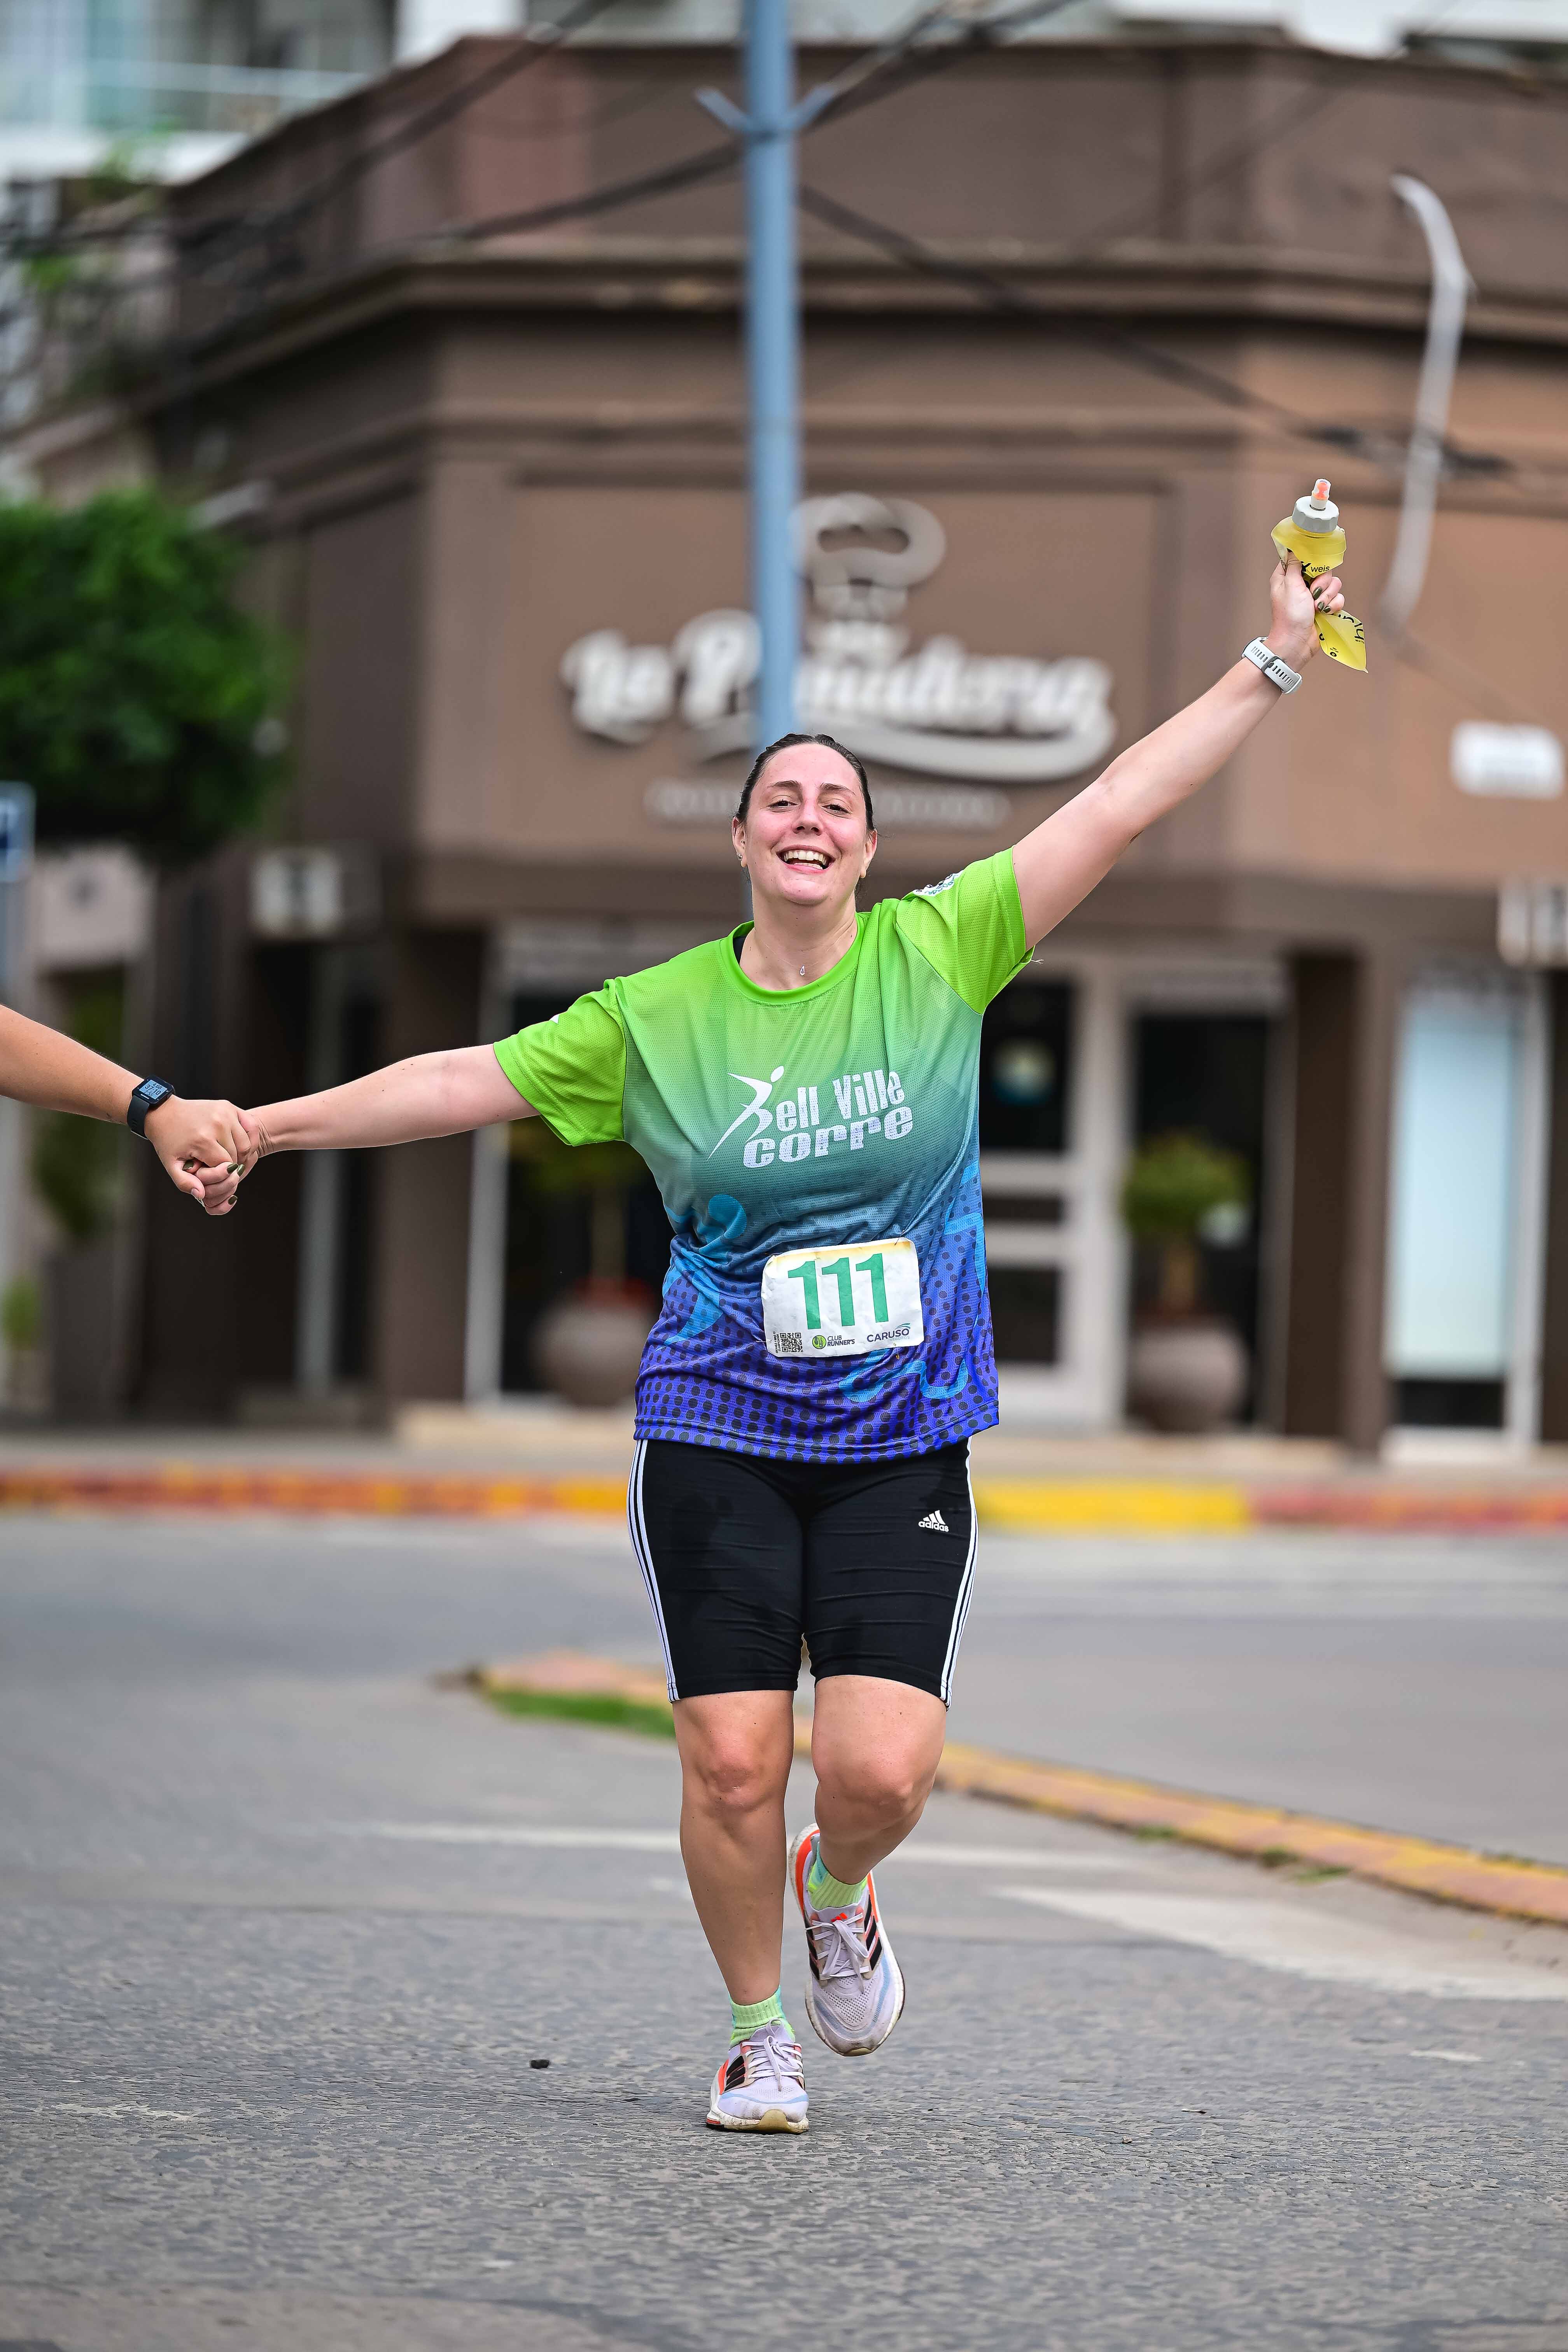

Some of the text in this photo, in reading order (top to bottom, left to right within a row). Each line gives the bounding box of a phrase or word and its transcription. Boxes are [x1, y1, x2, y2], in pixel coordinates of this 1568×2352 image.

[145, 1084, 161, 1095] 37:10
[832, 1069, 905, 1120] Ville
[743, 1106, 913, 1168] corre
[788, 1253, 889, 1330] 111
[866, 1328, 910, 1342] CARUSO
[918, 1521, 949, 1532] adidas
